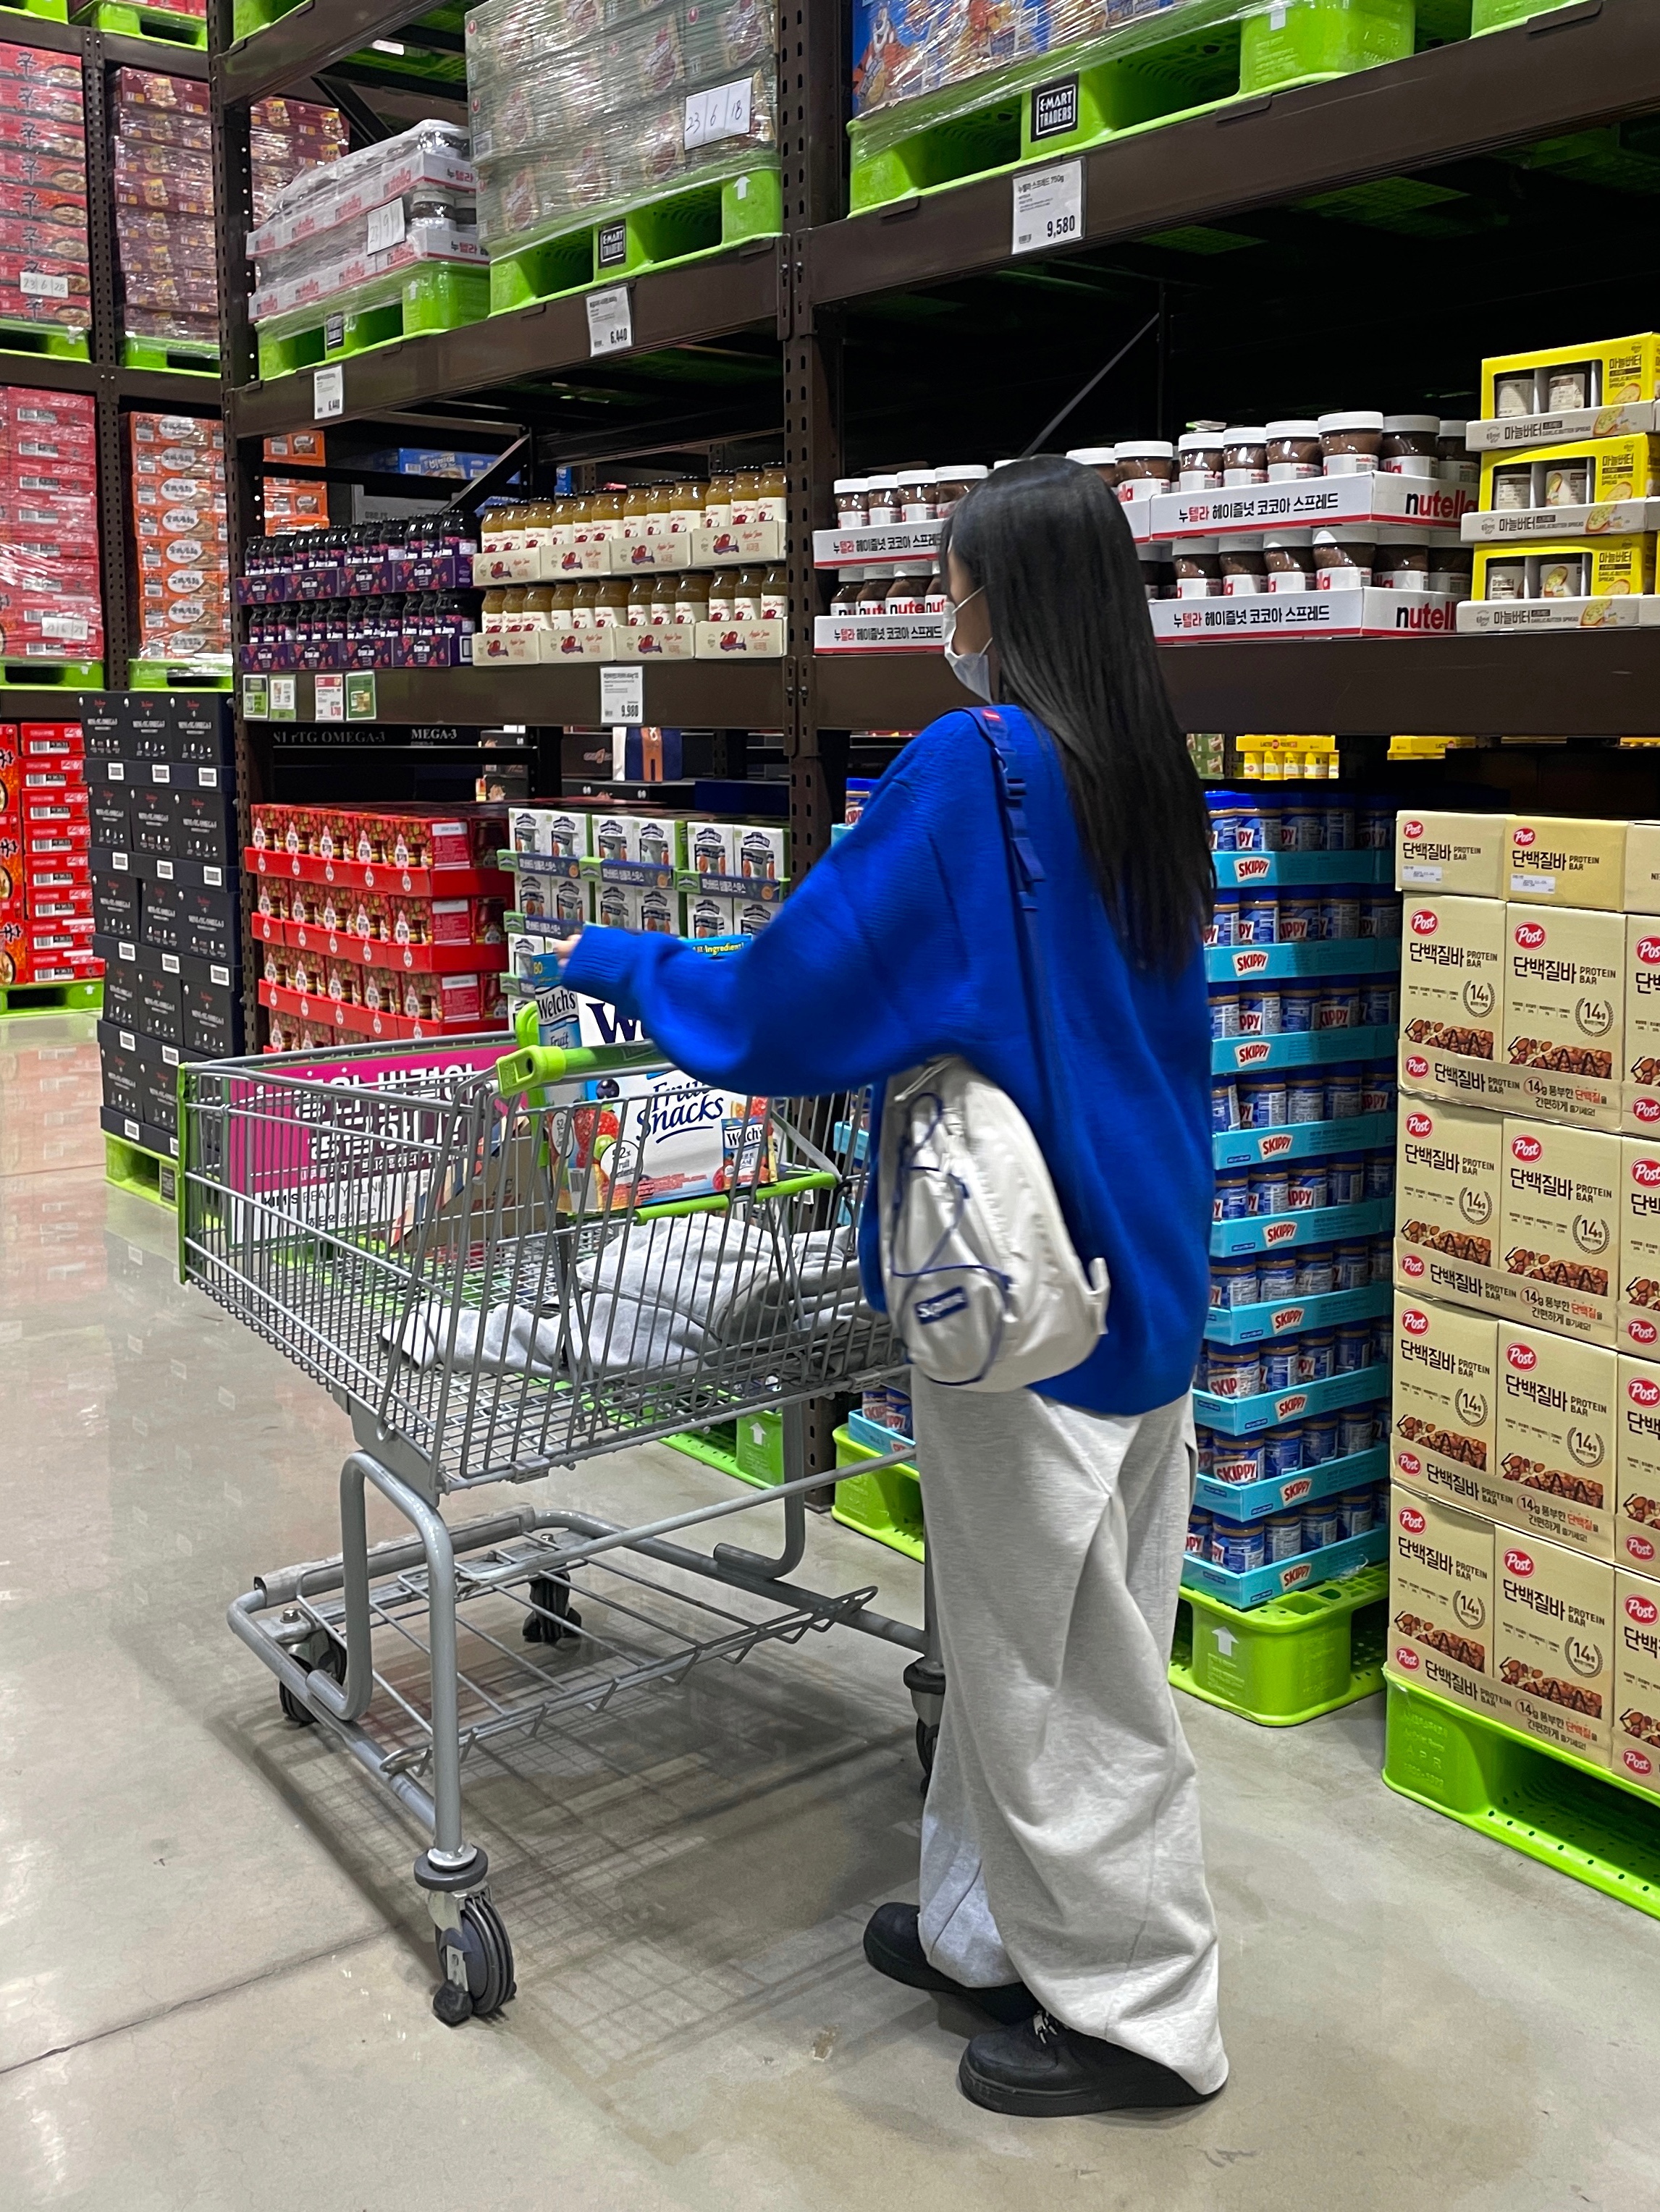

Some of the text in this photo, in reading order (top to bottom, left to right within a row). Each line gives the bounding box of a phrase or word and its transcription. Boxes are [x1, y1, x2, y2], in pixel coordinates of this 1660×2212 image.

[686, 99, 742, 132] 23 6 18
[1040, 106, 1072, 127] TRADERS
[1047, 215, 1075, 238] 9,580
[1505, 423, 1542, 439] 마늘버터
[1179, 492, 1339, 523] 누텔라 헤이즐넛 코코아 스프레드
[1499, 516, 1535, 531] 마늘버터
[888, 537, 911, 550] 코코아
[1174, 604, 1330, 628] 누텔라 헤이즐넛 코코아 스프레드
[1396, 601, 1457, 630] nutell
[1494, 610, 1530, 625] 마늘버터
[887, 626, 909, 640] 코코아
[911, 625, 943, 639] 스프레드
[321, 730, 385, 743] OMEGA-3
[411, 728, 458, 740] MEGA-3
[1514, 829, 1535, 843] Post
[1403, 843, 1452, 861] 단백질바
[1454, 846, 1481, 855] PROTEIN
[1239, 859, 1268, 878] SKIPPY
[1512, 849, 1567, 871] 단백질바
[1569, 856, 1599, 864] PROTEIN
[1412, 913, 1436, 929] Post
[1517, 926, 1543, 943] Post
[1236, 953, 1267, 971] SKIPPY
[1410, 942, 1465, 968] 단백질바
[1467, 950, 1498, 962] PROTEIN
[1467, 959, 1482, 968] BAR
[534, 961, 543, 974] 80
[1514, 956, 1577, 984] 단백질바
[1580, 966, 1616, 979] PROTEIN
[1580, 976, 1597, 985] BAR
[1470, 985, 1488, 1002] 14g
[538, 989, 576, 1019] Welch's
[1584, 1002, 1606, 1020] 14g
[1239, 1044, 1268, 1063] SKIPPY
[1407, 1058, 1427, 1073] Post
[1435, 1063, 1485, 1093] 단백질바
[1488, 1078, 1520, 1091] PROTEIN
[1488, 1086, 1504, 1095] BAR
[1528, 1078, 1547, 1096] 14g
[1549, 1084, 1574, 1100] 풍부한
[1535, 1097, 1568, 1113] 간편하게
[1635, 1102, 1659, 1117] Post
[636, 1094, 724, 1141] Snacks
[1408, 1117, 1430, 1133] Post
[1263, 1136, 1292, 1155] SKIPPY
[1514, 1140, 1540, 1156] Post
[1405, 1144, 1459, 1173] 단백질바
[1462, 1158, 1494, 1171] PROTEIN
[1462, 1167, 1478, 1175] BAR
[1510, 1168, 1573, 1199] 단백질바
[1576, 1184, 1612, 1199] PROTEIN
[1467, 1193, 1486, 1210] 14g
[1576, 1193, 1593, 1203] BAR
[1268, 1224, 1295, 1243] SKIPPY
[1582, 1219, 1603, 1238] 14g
[1403, 1258, 1423, 1272] Post
[1431, 1264, 1483, 1296] 단백질바
[1486, 1283, 1516, 1298] PROTEIN
[1486, 1291, 1501, 1301] BAR
[1524, 1288, 1543, 1306] 14g
[1546, 1297, 1570, 1312] 풍부한
[1275, 1309, 1302, 1329] SKIPPY
[1404, 1314, 1426, 1329] Post
[1532, 1307, 1564, 1324] 간편하게
[1631, 1325, 1653, 1339] Post
[1401, 1339, 1456, 1375] 단백질바
[1509, 1348, 1535, 1366] Post
[1458, 1359, 1490, 1375] PROTEIN
[1458, 1368, 1474, 1378] BAR
[1506, 1374, 1568, 1412] 단백질바
[1631, 1382, 1660, 1401] Post
[1278, 1396, 1306, 1415] SKIPPY
[1570, 1396, 1607, 1414] PROTEIN
[1570, 1406, 1588, 1417] BAR
[1399, 1456, 1419, 1471] Post
[1216, 1462, 1257, 1483] SKIPPY
[1284, 1480, 1311, 1500] SKIPPY
[1426, 1463, 1479, 1500] 단백질바
[1520, 1498, 1540, 1514] 14g
[1401, 1512, 1423, 1529] Post
[1398, 1537, 1453, 1575] 단백질바
[1506, 1554, 1533, 1572] Post
[1283, 1565, 1310, 1585] SKIPPY
[1503, 1579, 1564, 1621] 단백질바
[1568, 1606, 1605, 1626] PROTEIN
[1627, 1601, 1656, 1619] Post
[1568, 1616, 1586, 1628] BAR
[1397, 1650, 1417, 1666] Post
[1425, 1660, 1478, 1701] 단백질바
[1520, 1700, 1539, 1718] 14g
